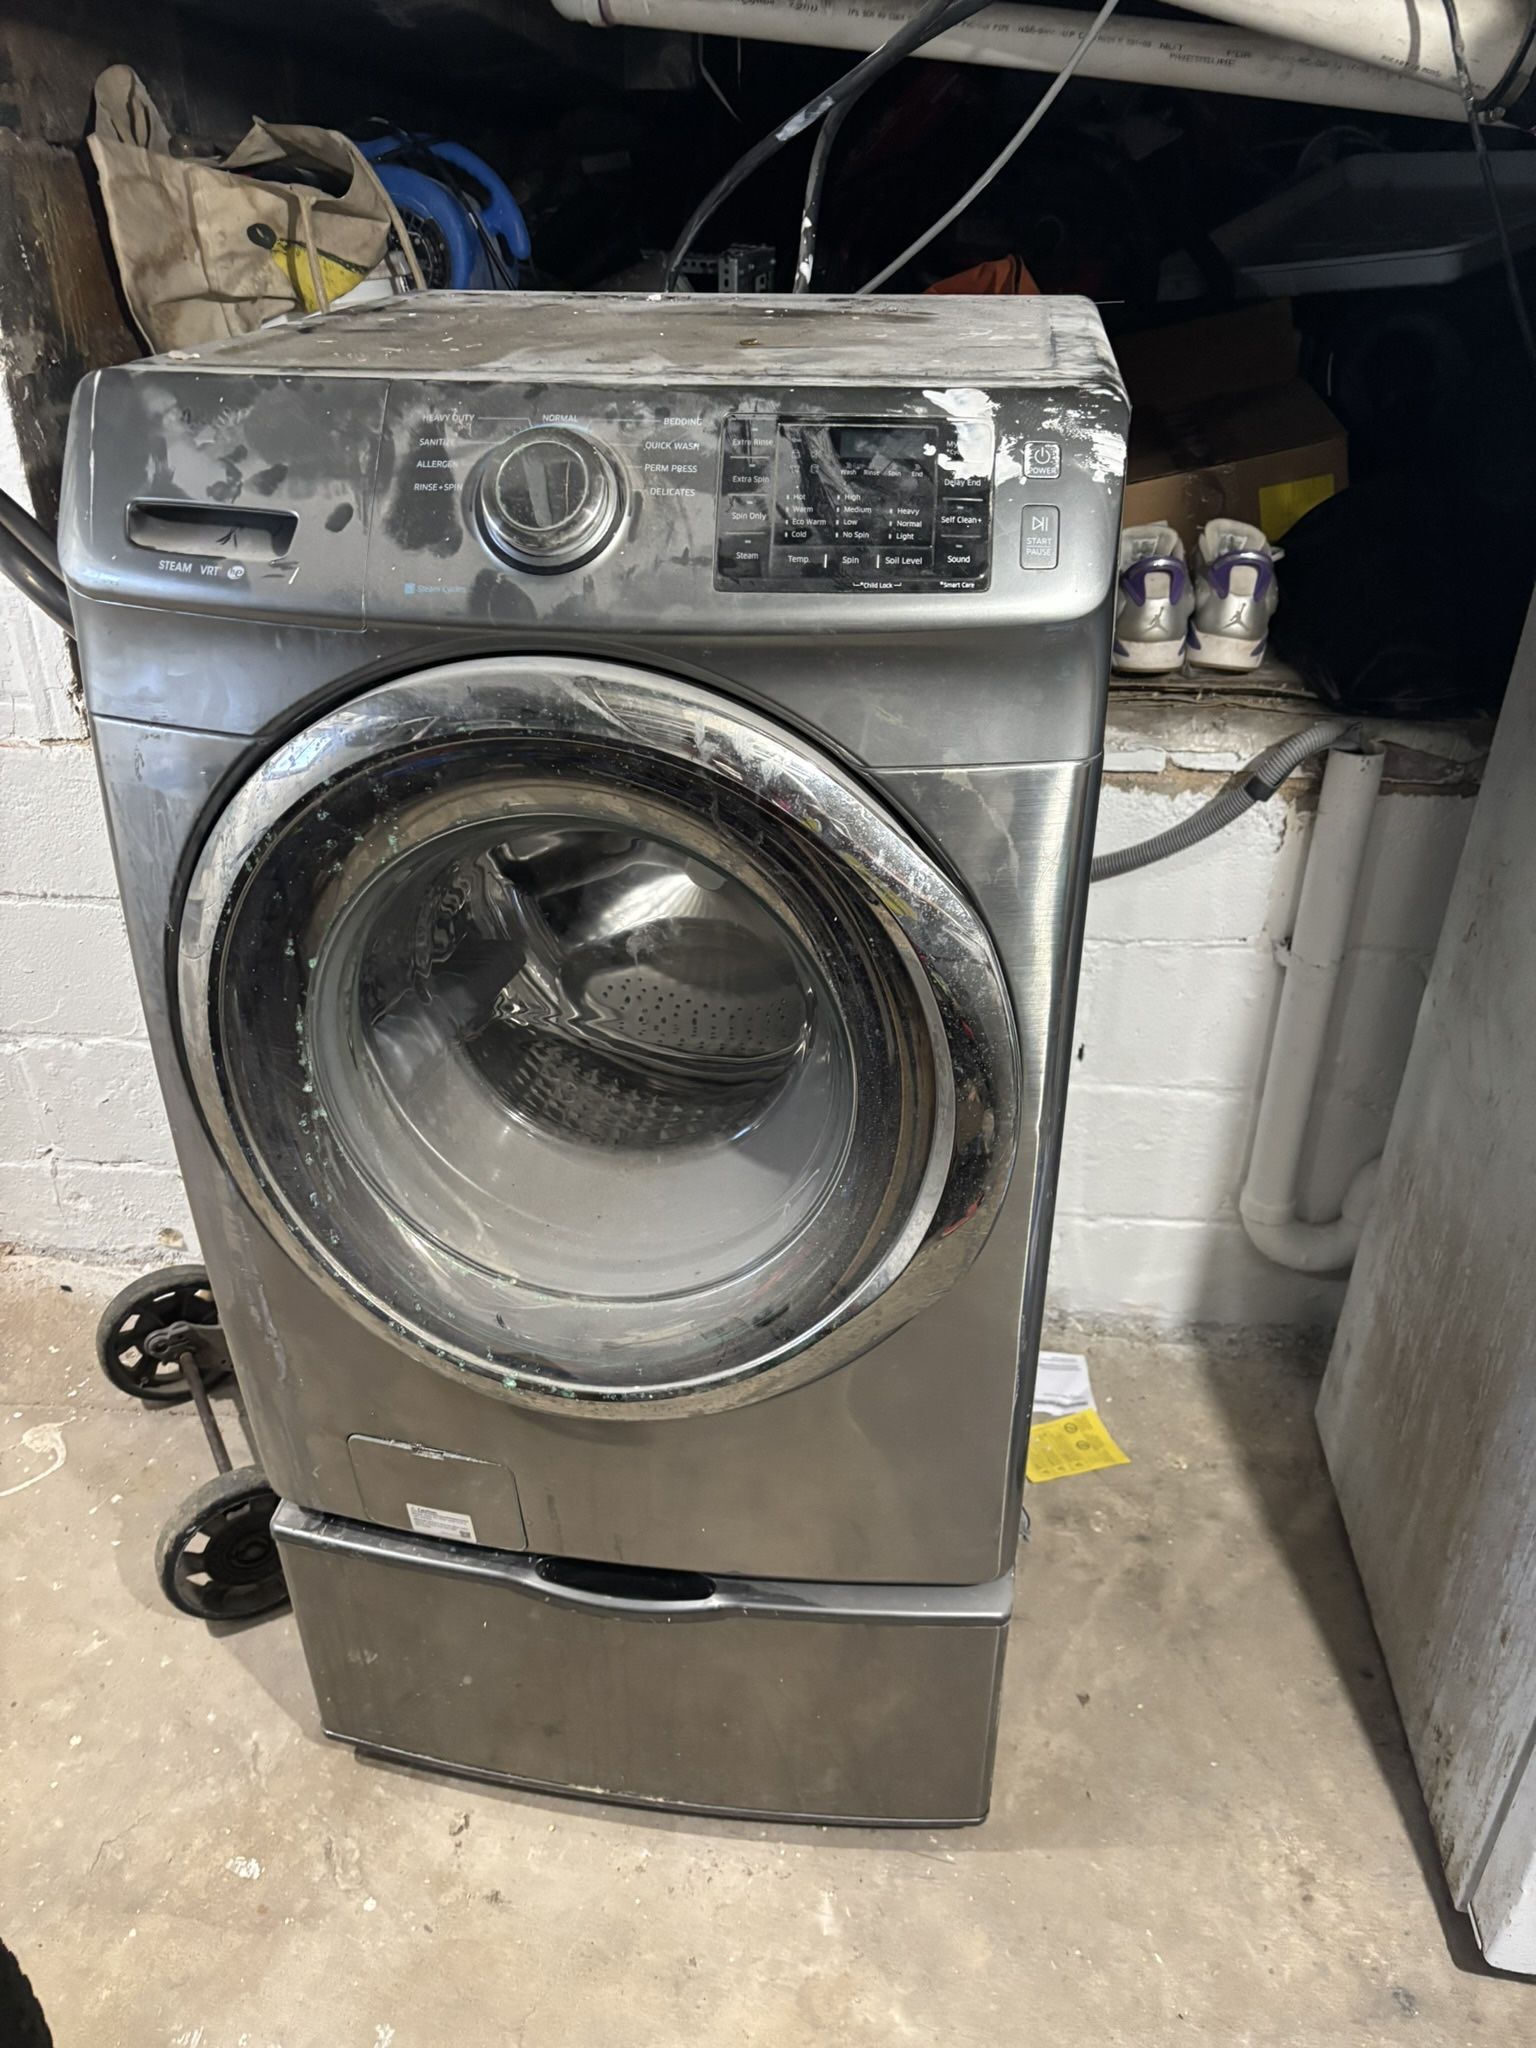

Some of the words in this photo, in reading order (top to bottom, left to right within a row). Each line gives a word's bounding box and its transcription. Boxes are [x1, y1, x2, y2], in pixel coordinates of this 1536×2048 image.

[422, 414, 451, 422] HEAVY
[452, 414, 475, 422] DUTY
[542, 414, 578, 423] NORMAL
[663, 417, 703, 426] BEDDING
[645, 441, 671, 450] QUICK
[674, 442, 700, 451] WASH
[753, 438, 773, 446] Rinse
[416, 460, 458, 469] ALLERGEN
[644, 463, 669, 472] PERM
[671, 464, 698, 473] PRESS
[1028, 467, 1057, 475] POWER
[732, 475, 752, 483] Extra
[753, 475, 770, 484] Spin
[944, 478, 965, 487] Delay
[967, 479, 981, 487] End
[650, 488, 696, 497] DELICATES
[844, 493, 861, 502] High
[731, 511, 748, 520] Spin
[749, 512, 767, 521] Only
[897, 507, 920, 516] Heavy
[896, 520, 922, 528] Normal
[941, 515, 955, 524] Self
[854, 532, 870, 540] Spin
[896, 532, 914, 541] Light
[1026, 537, 1052, 545] START
[735, 551, 759, 560] Steam
[1026, 548, 1051, 556] PAUSE
[842, 556, 860, 565] Spin
[885, 556, 900, 565] Soil
[901, 556, 923, 565] Level
[947, 555, 971, 564] Sound
[158, 559, 193, 574] STEAM
[199, 564, 220, 577] VRT
[880, 581, 893, 589] Lock
[961, 581, 975, 589] Care
